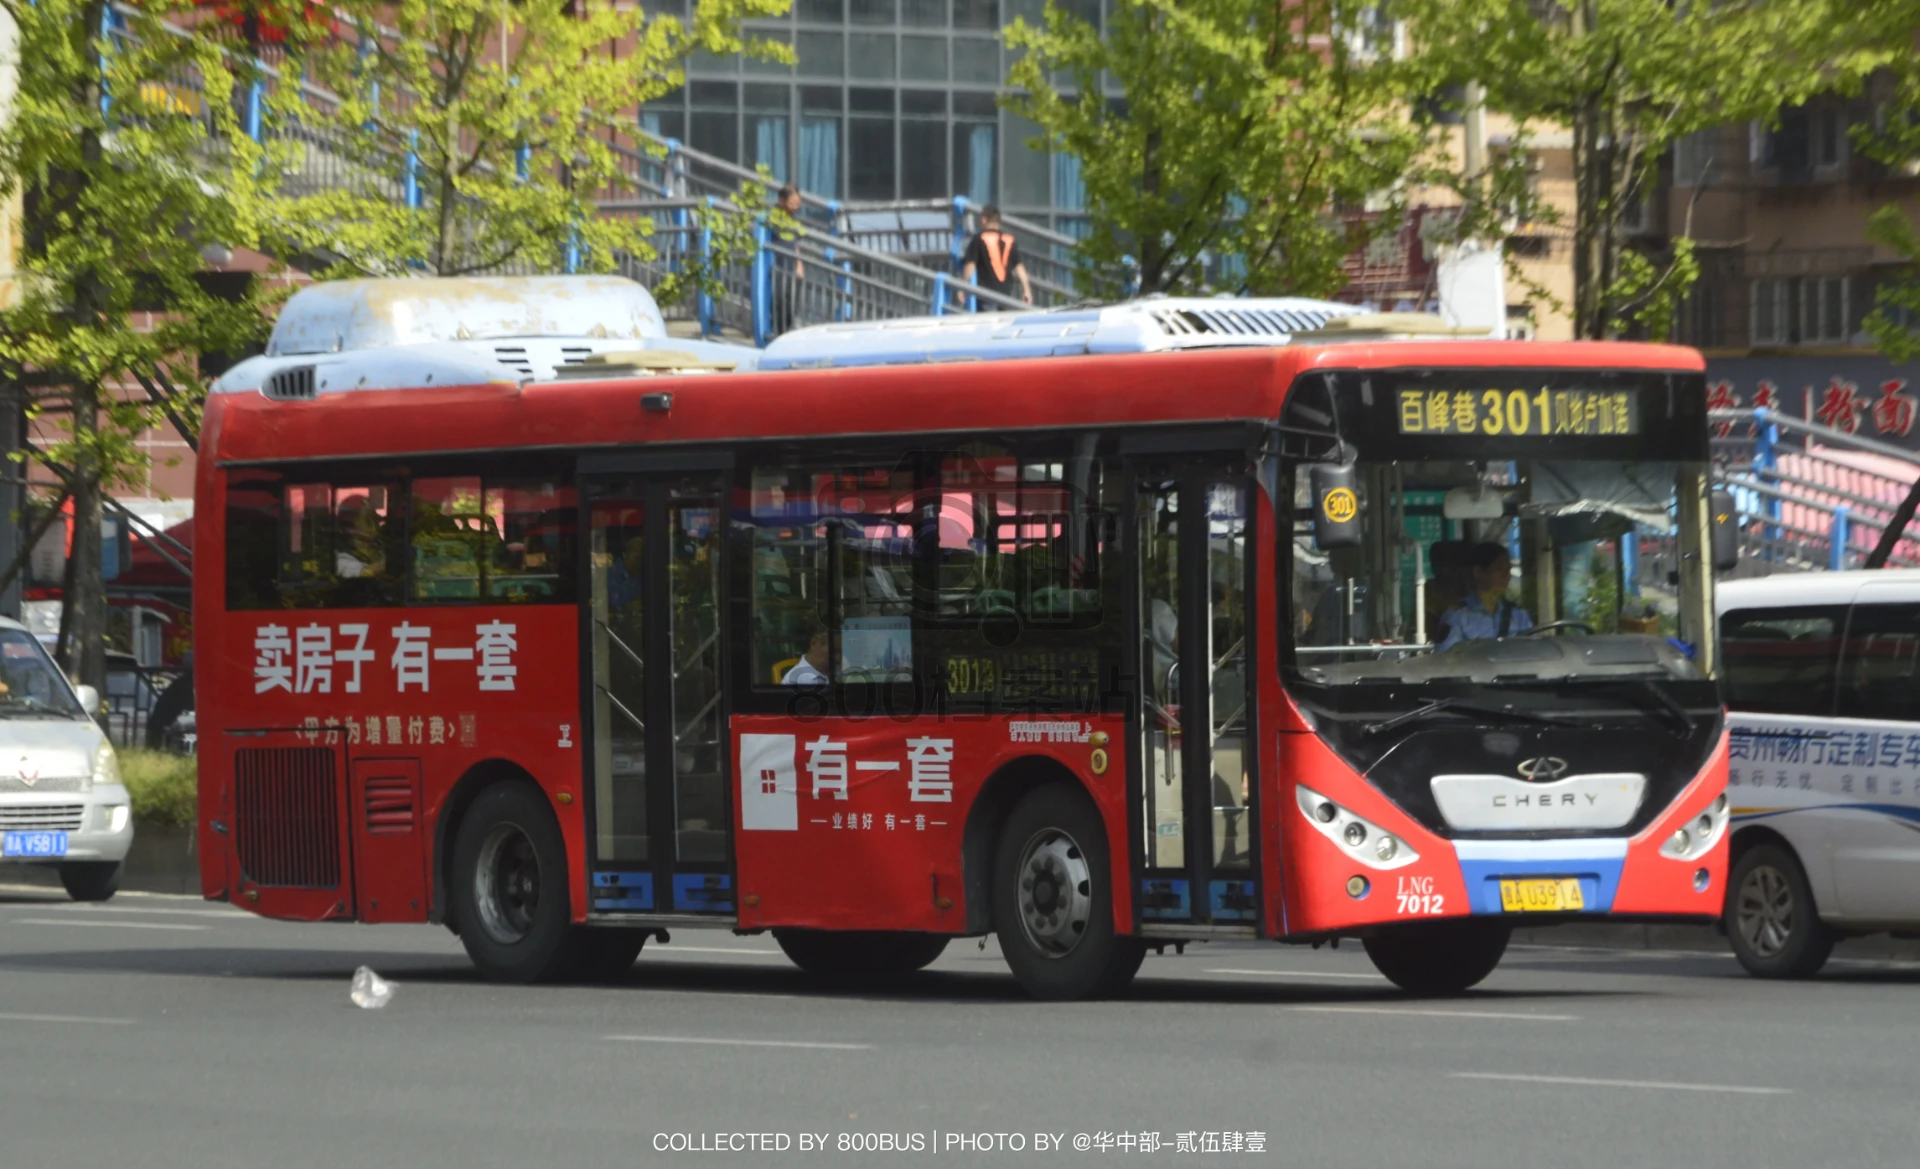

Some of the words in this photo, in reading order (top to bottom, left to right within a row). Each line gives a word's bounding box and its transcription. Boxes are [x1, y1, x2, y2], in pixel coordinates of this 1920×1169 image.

[1400, 390, 1477, 433] 百峰巷
[1481, 388, 1551, 436] 301
[1329, 496, 1354, 516] 301
[254, 622, 376, 694] 卖房子
[391, 619, 518, 693] 有一套
[804, 734, 954, 802] 有一套
[1492, 793, 1599, 807] CHERY
[832, 812, 873, 830] 业绩好
[884, 813, 926, 831] 有一套
[1397, 876, 1434, 896] LNG
[1396, 894, 1445, 915] 7012
